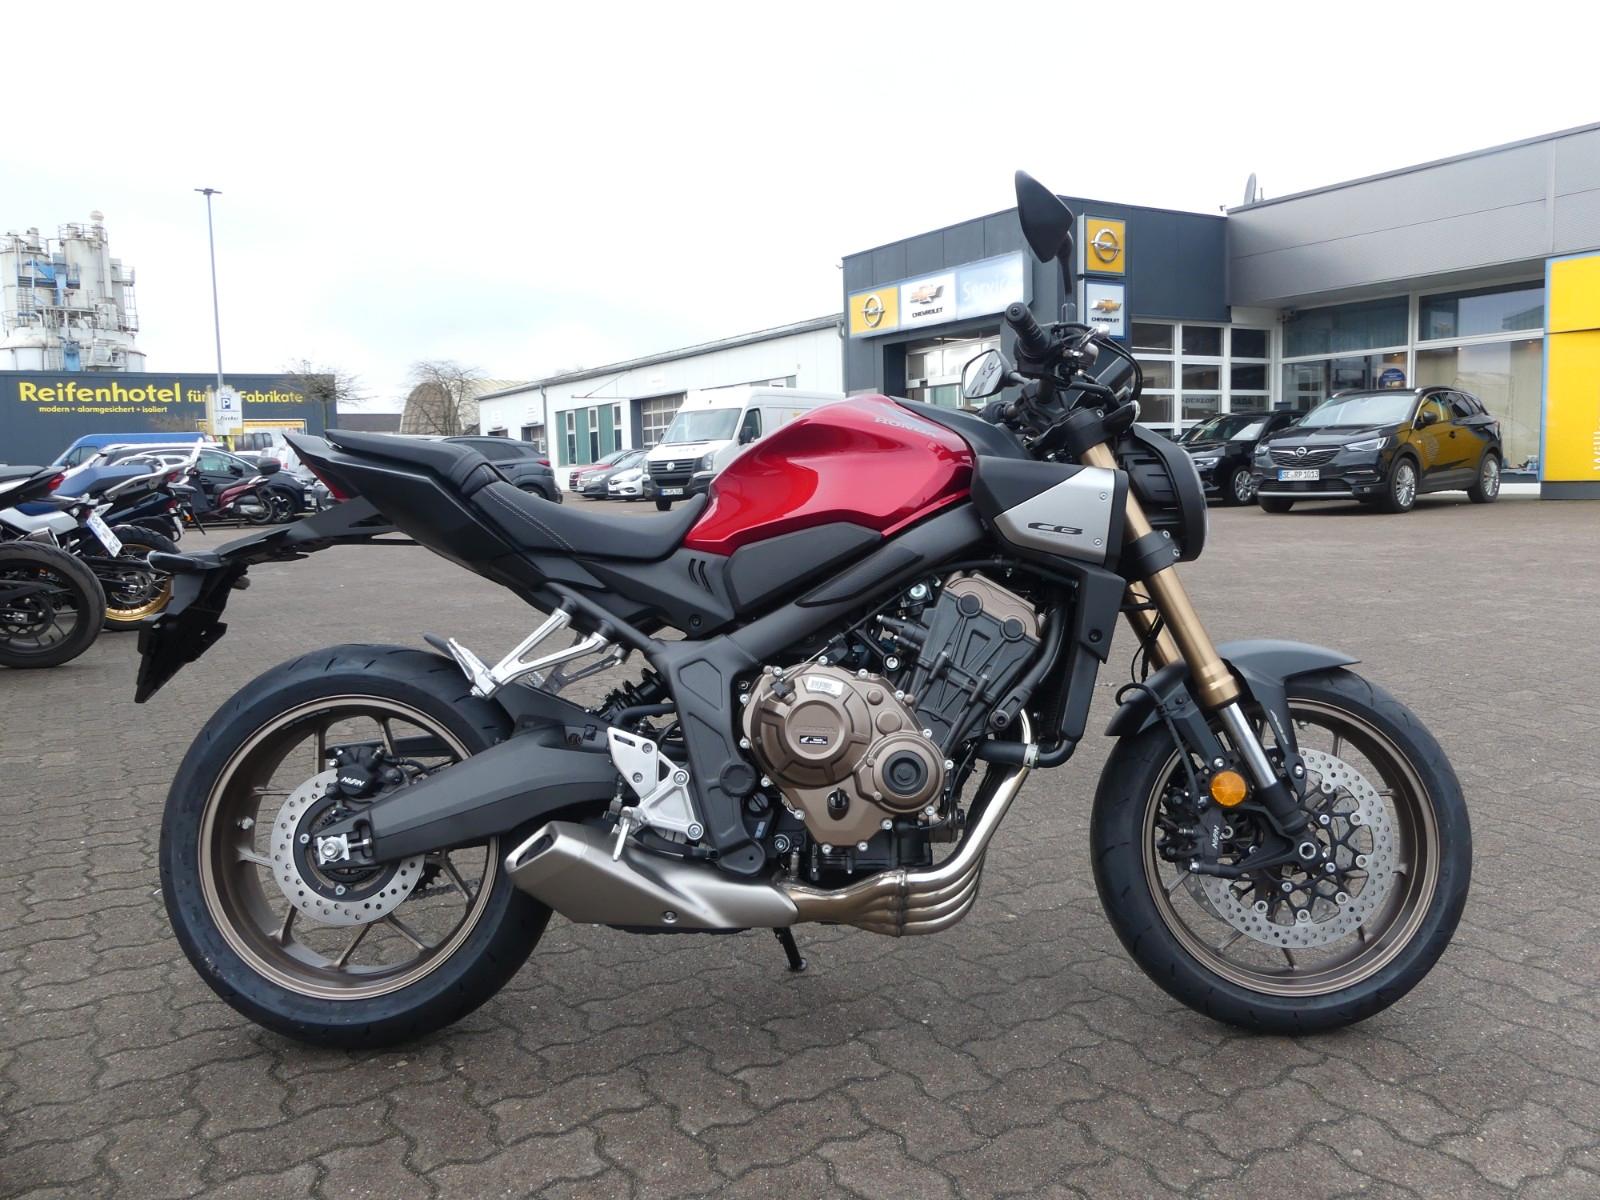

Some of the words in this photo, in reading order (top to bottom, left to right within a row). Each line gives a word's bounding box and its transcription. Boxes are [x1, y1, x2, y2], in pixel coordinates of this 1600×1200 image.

[912, 307, 943, 318] CHEVROLET
[19, 381, 181, 402] Reifenhotel
[239, 391, 304, 403] Fabrikate
[39, 405, 69, 413] modern
[77, 405, 134, 414] alarmgesichert
[142, 405, 168, 413] isoliert
[876, 416, 937, 436] HONDA
